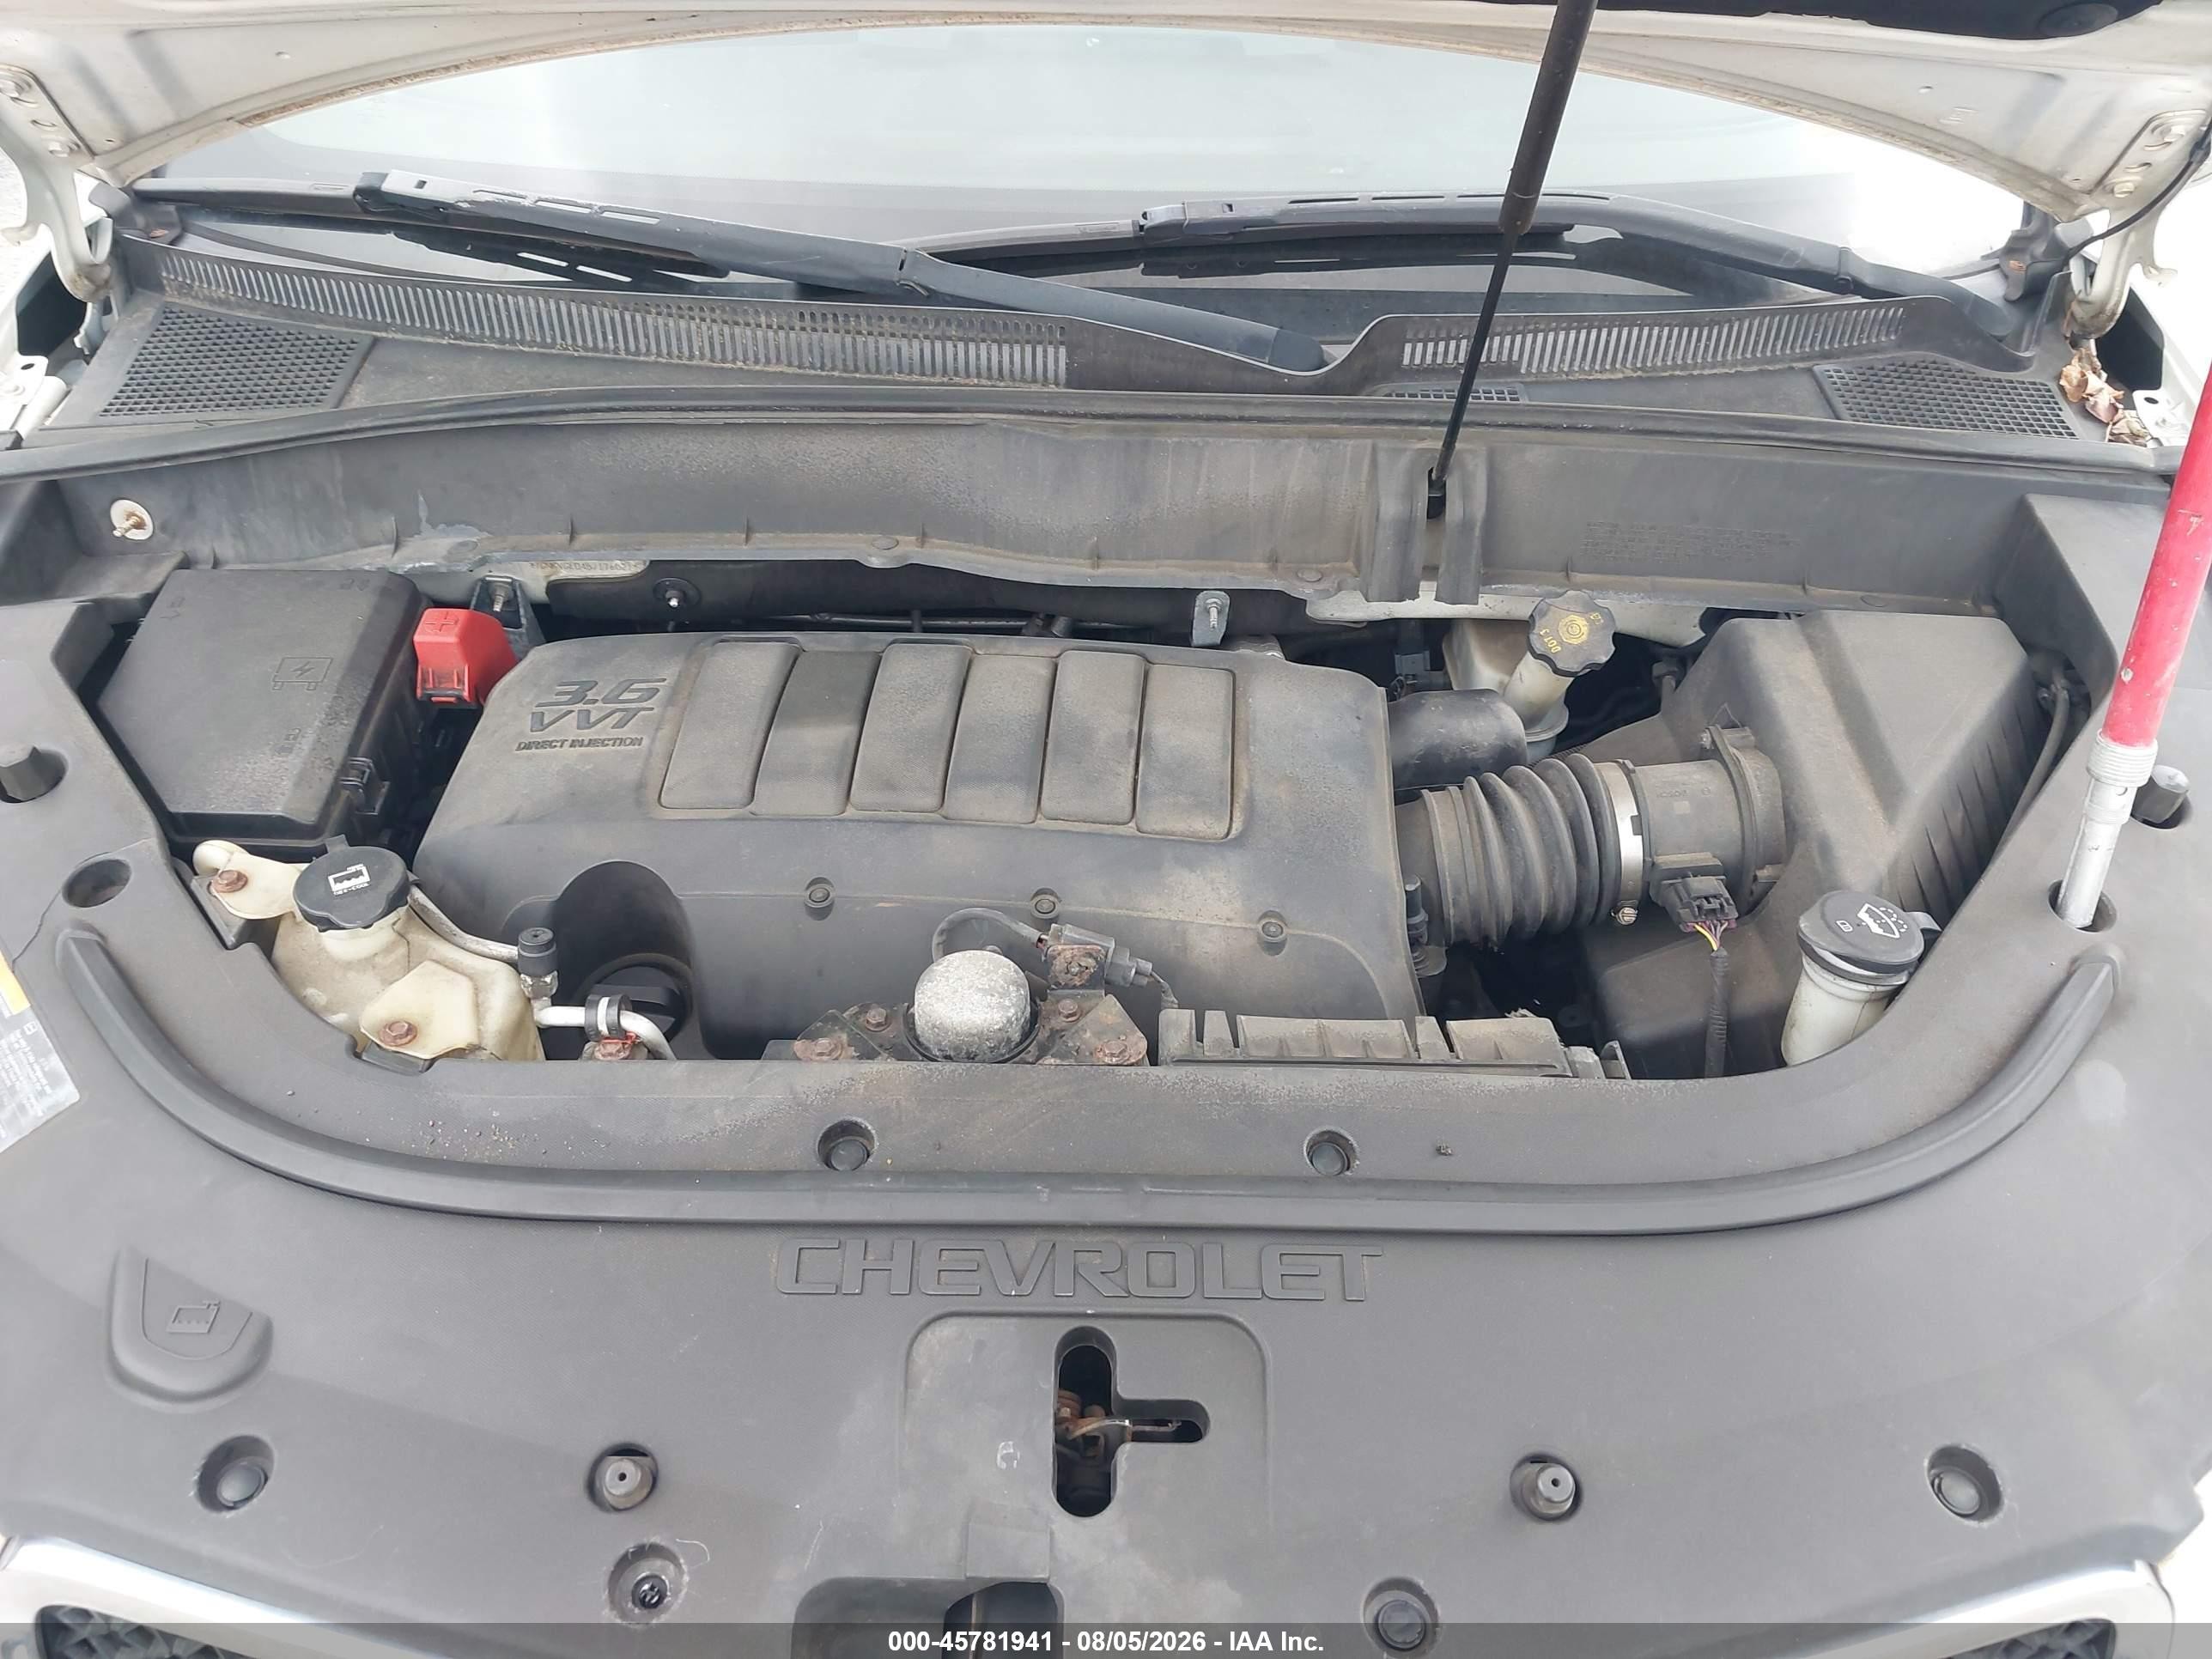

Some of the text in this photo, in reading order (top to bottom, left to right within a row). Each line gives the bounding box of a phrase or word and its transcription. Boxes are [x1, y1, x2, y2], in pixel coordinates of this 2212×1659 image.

[534, 678, 667, 708] 3.6
[530, 707, 655, 732] VVT
[515, 737, 644, 751] DIRECT INJECTION
[777, 1237, 1383, 1302] CHEVROLET
